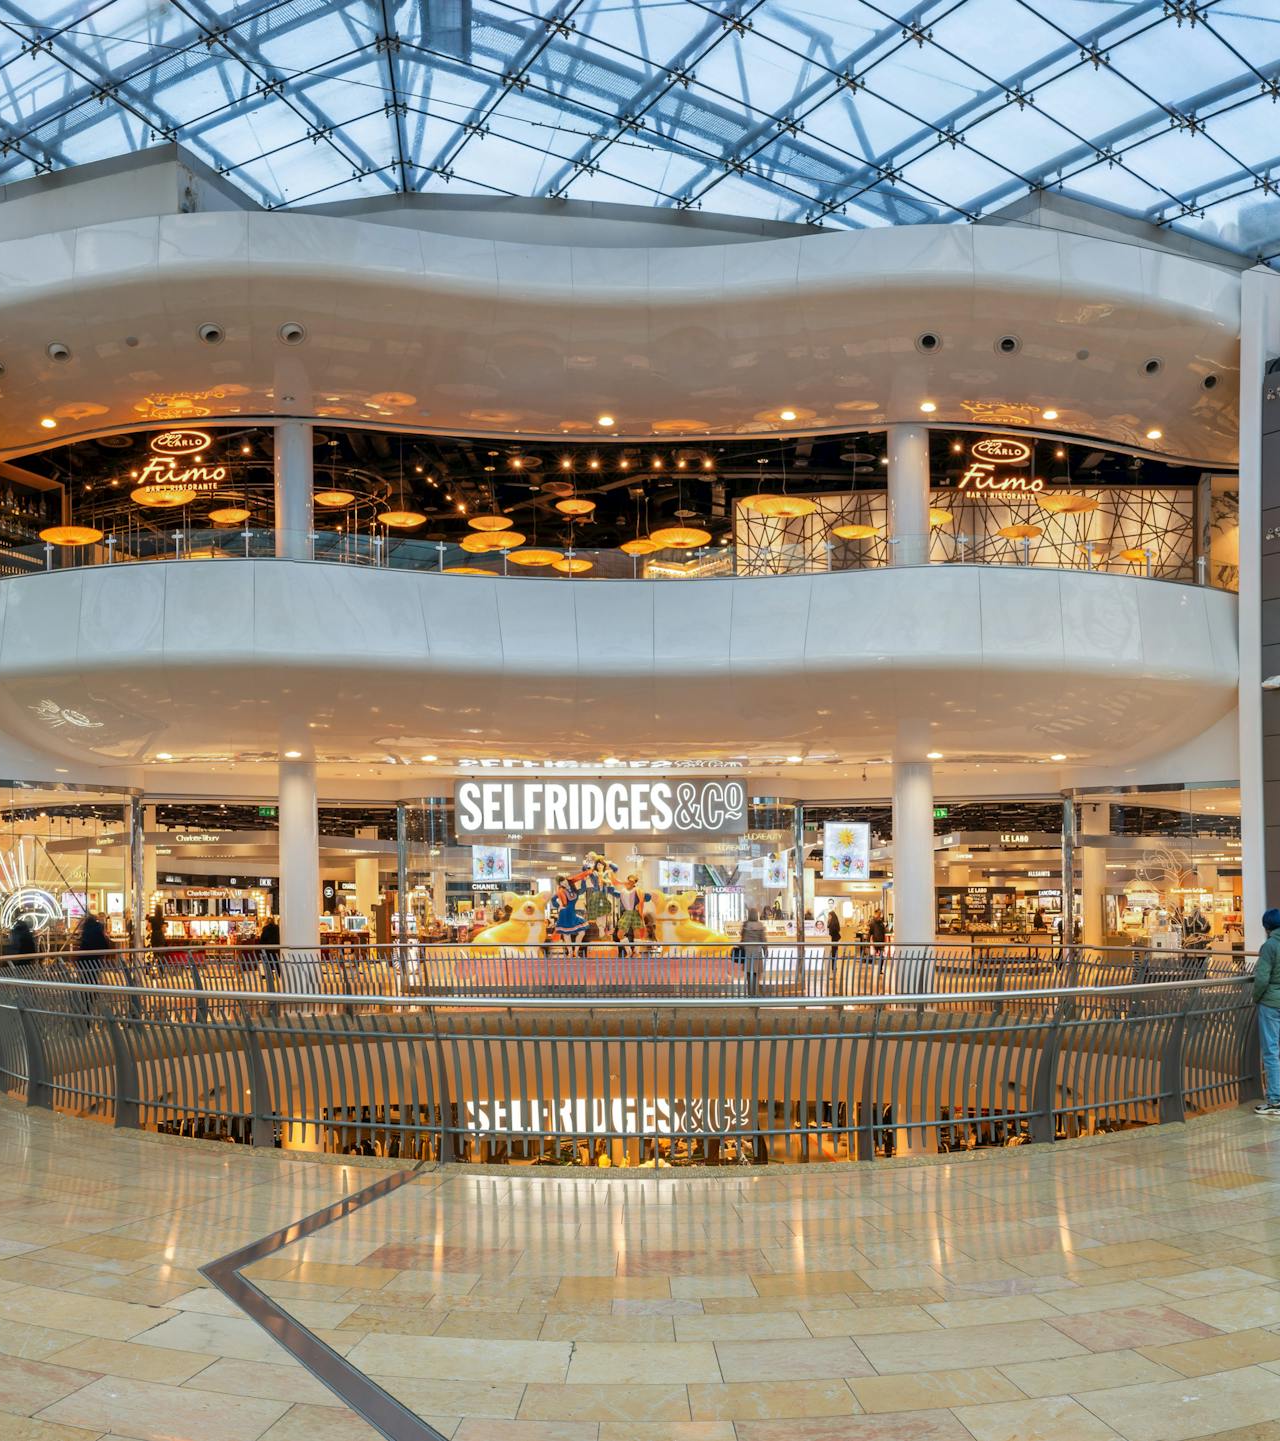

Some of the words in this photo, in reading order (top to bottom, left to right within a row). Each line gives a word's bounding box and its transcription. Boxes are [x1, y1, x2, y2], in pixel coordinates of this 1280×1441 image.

[168, 438, 202, 447] CARLO
[988, 448, 1022, 456] CARLO
[137, 456, 226, 484] Fumo
[958, 463, 1044, 491] Fumo
[170, 482, 218, 492] RISTORANTE
[966, 491, 980, 499] BAR
[989, 491, 1035, 500] RISTORANTE
[1001, 835, 1010, 843] LE
[471, 883, 500, 891] CHANEL
